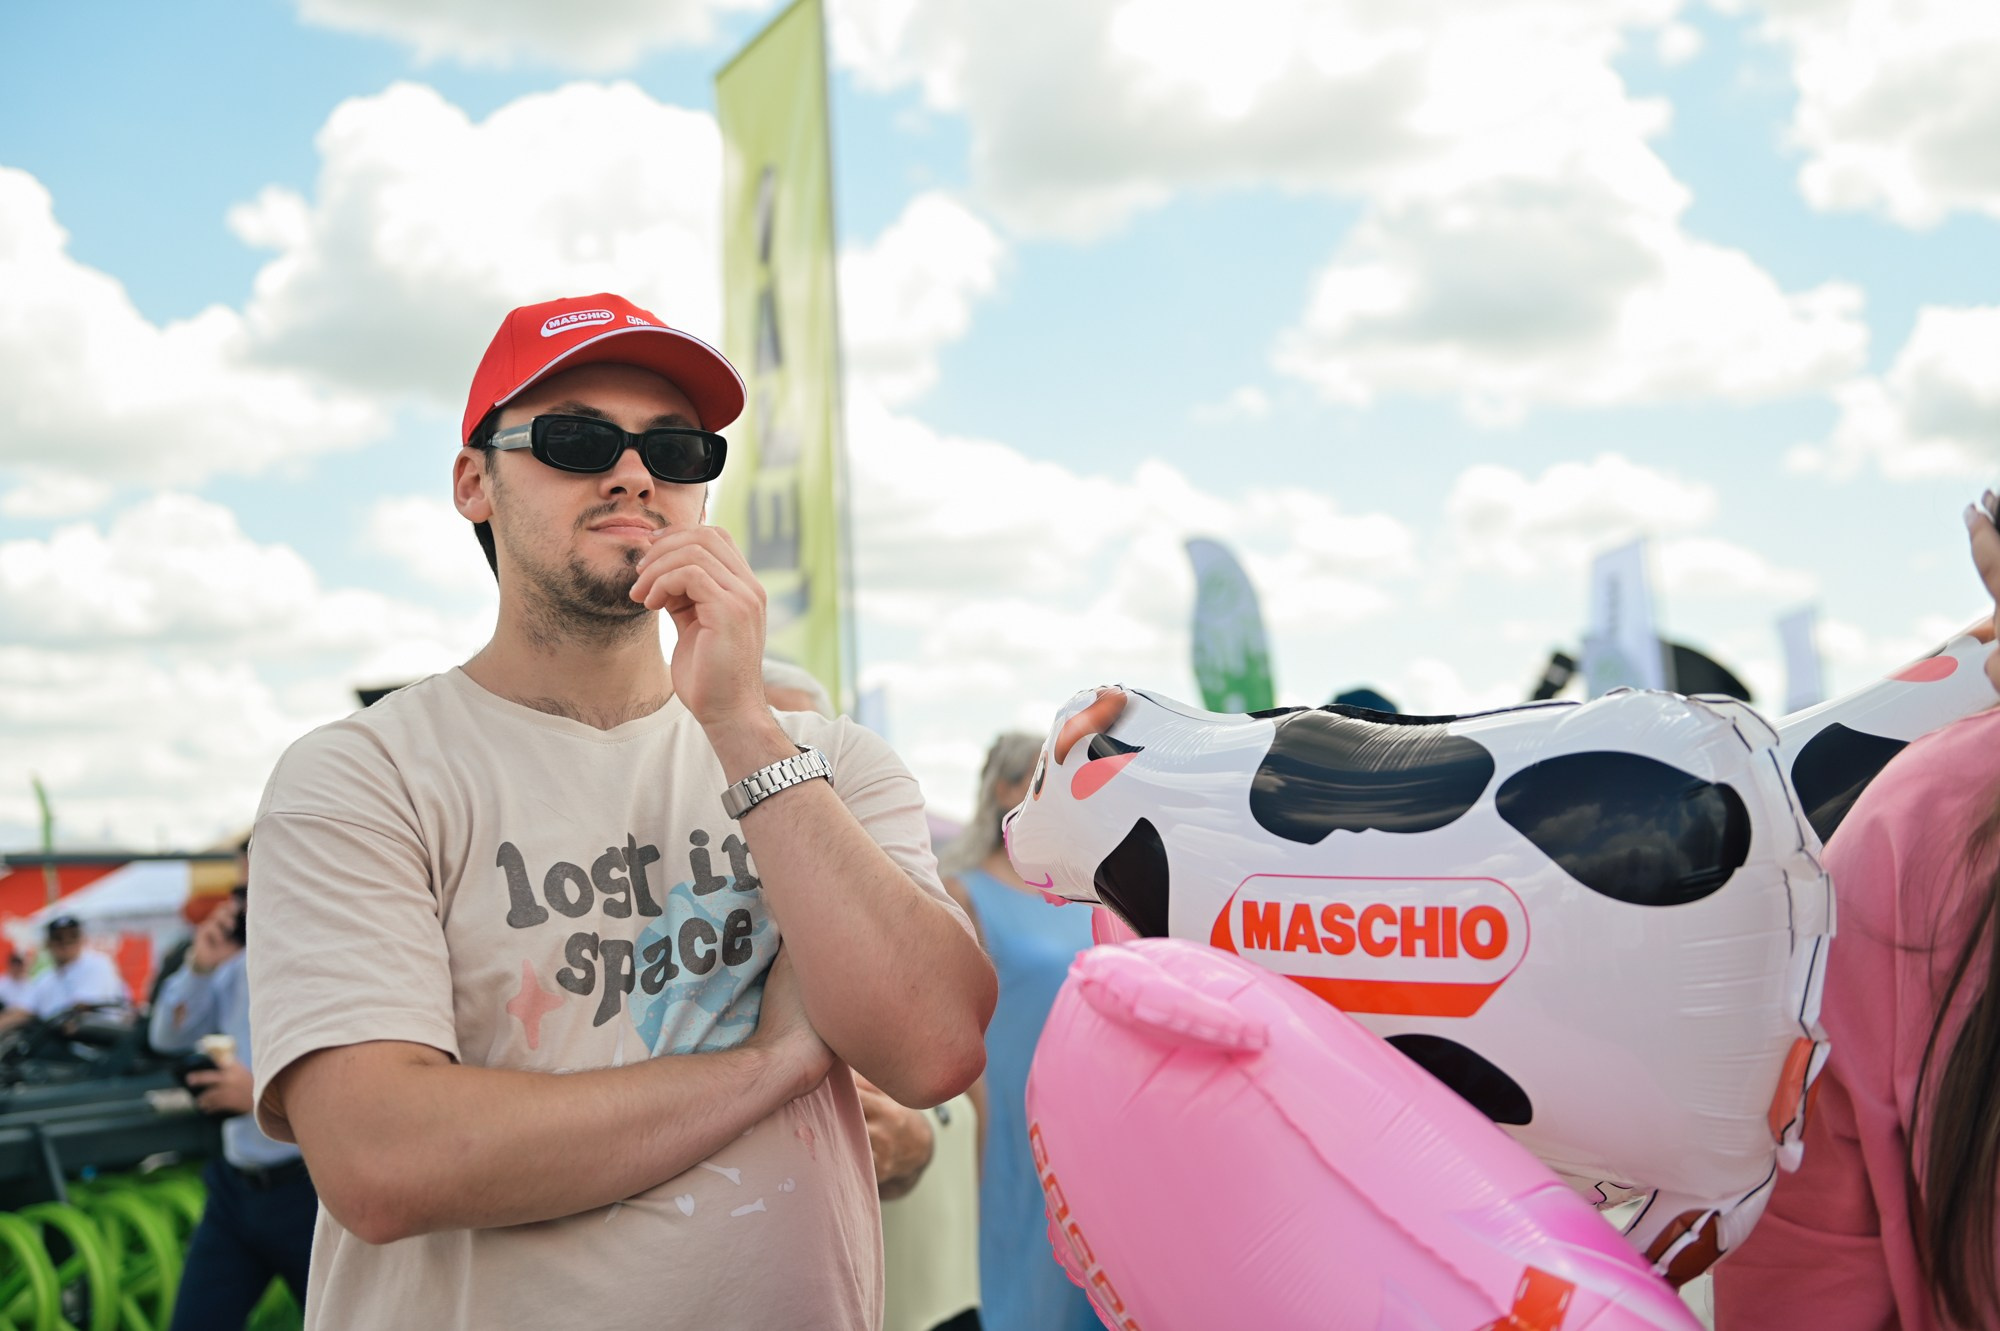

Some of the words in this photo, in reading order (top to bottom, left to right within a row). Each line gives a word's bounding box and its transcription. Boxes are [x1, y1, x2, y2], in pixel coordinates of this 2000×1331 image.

[549, 311, 610, 329] MASCHIO
[496, 832, 662, 928] lost
[556, 908, 753, 1027] space
[1242, 900, 1509, 960] MASCHIO
